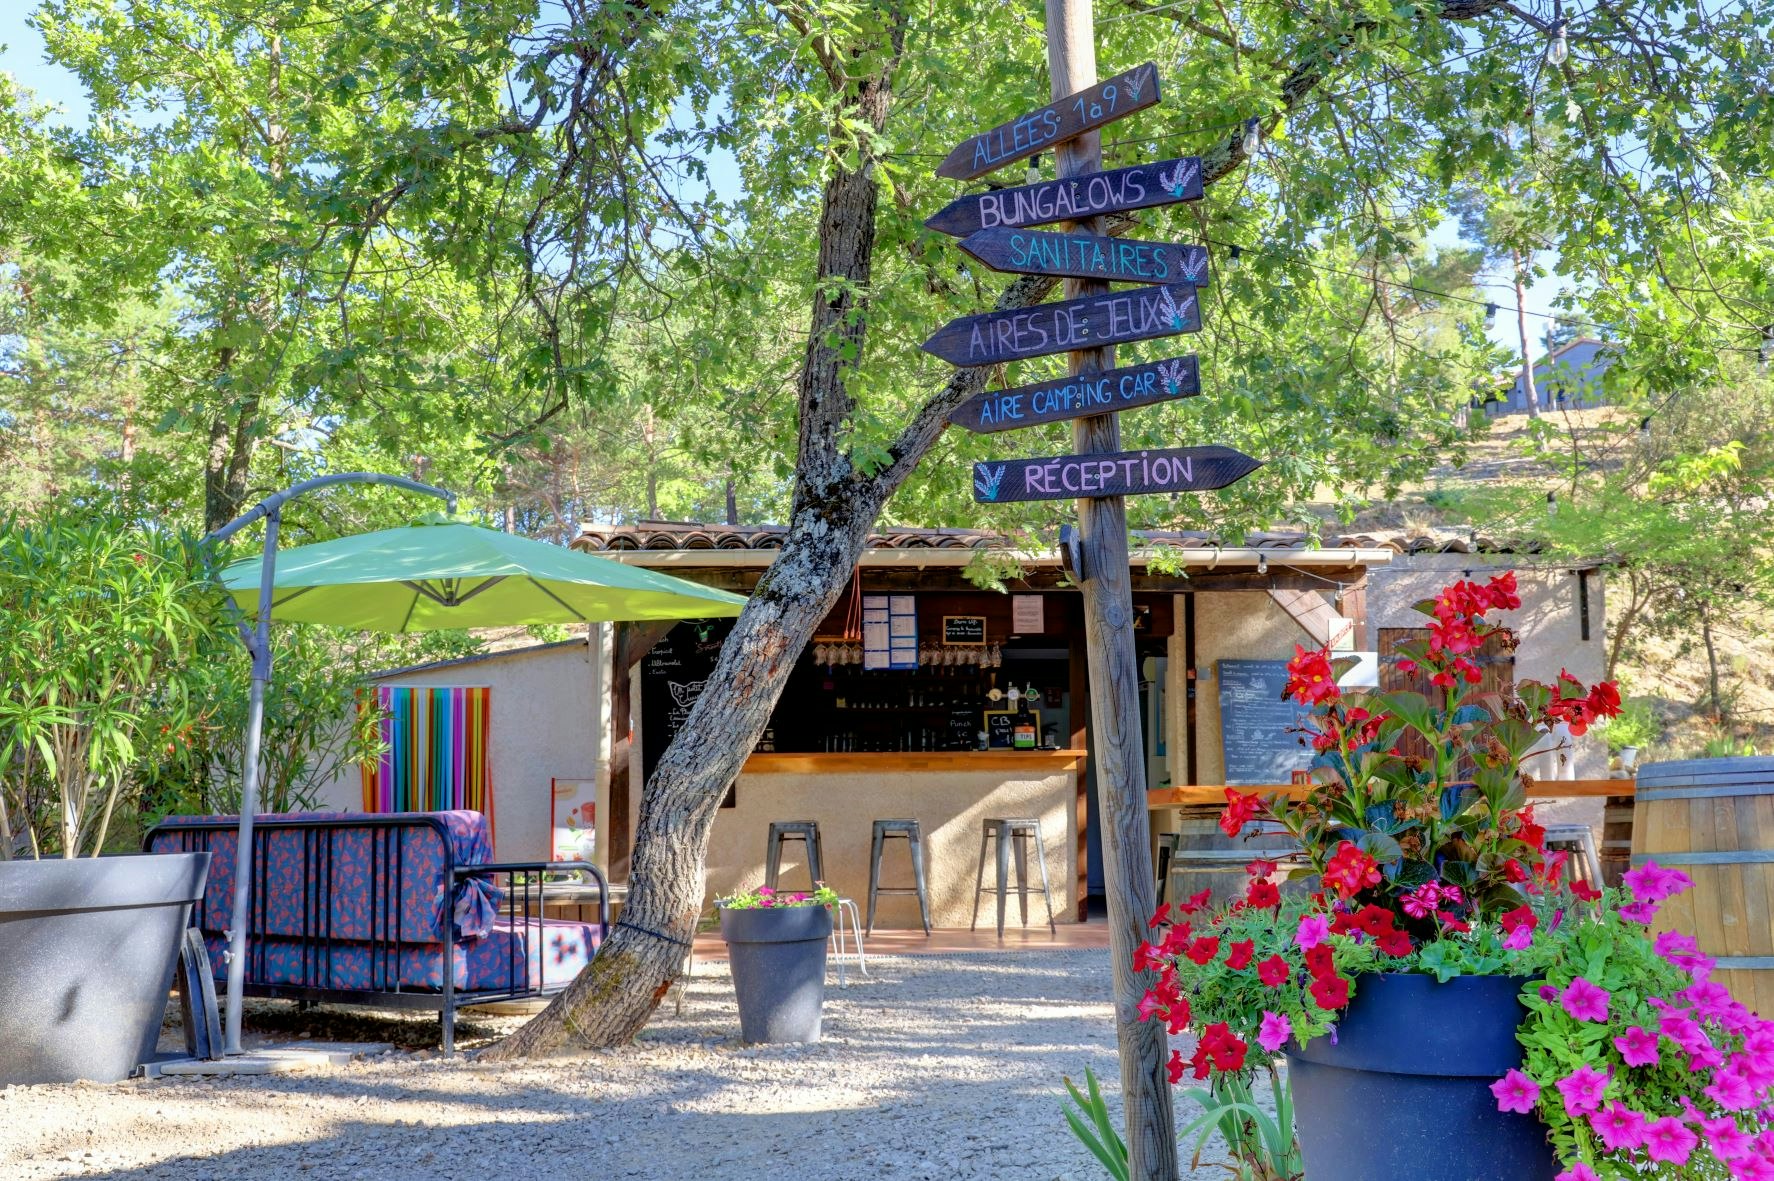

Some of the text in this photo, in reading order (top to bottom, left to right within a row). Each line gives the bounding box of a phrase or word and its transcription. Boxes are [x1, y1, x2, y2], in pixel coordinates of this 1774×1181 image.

[972, 109, 1058, 170] ALLÉES
[979, 170, 1145, 228] BUNGALOWS
[1010, 234, 1168, 279] SANITAIRES
[969, 294, 1165, 359] AIRES DE JEUX
[981, 372, 1156, 425] AIRE CAMPING CAR
[1025, 451, 1194, 494] RÉCEPTION
[991, 716, 1011, 726] CB
